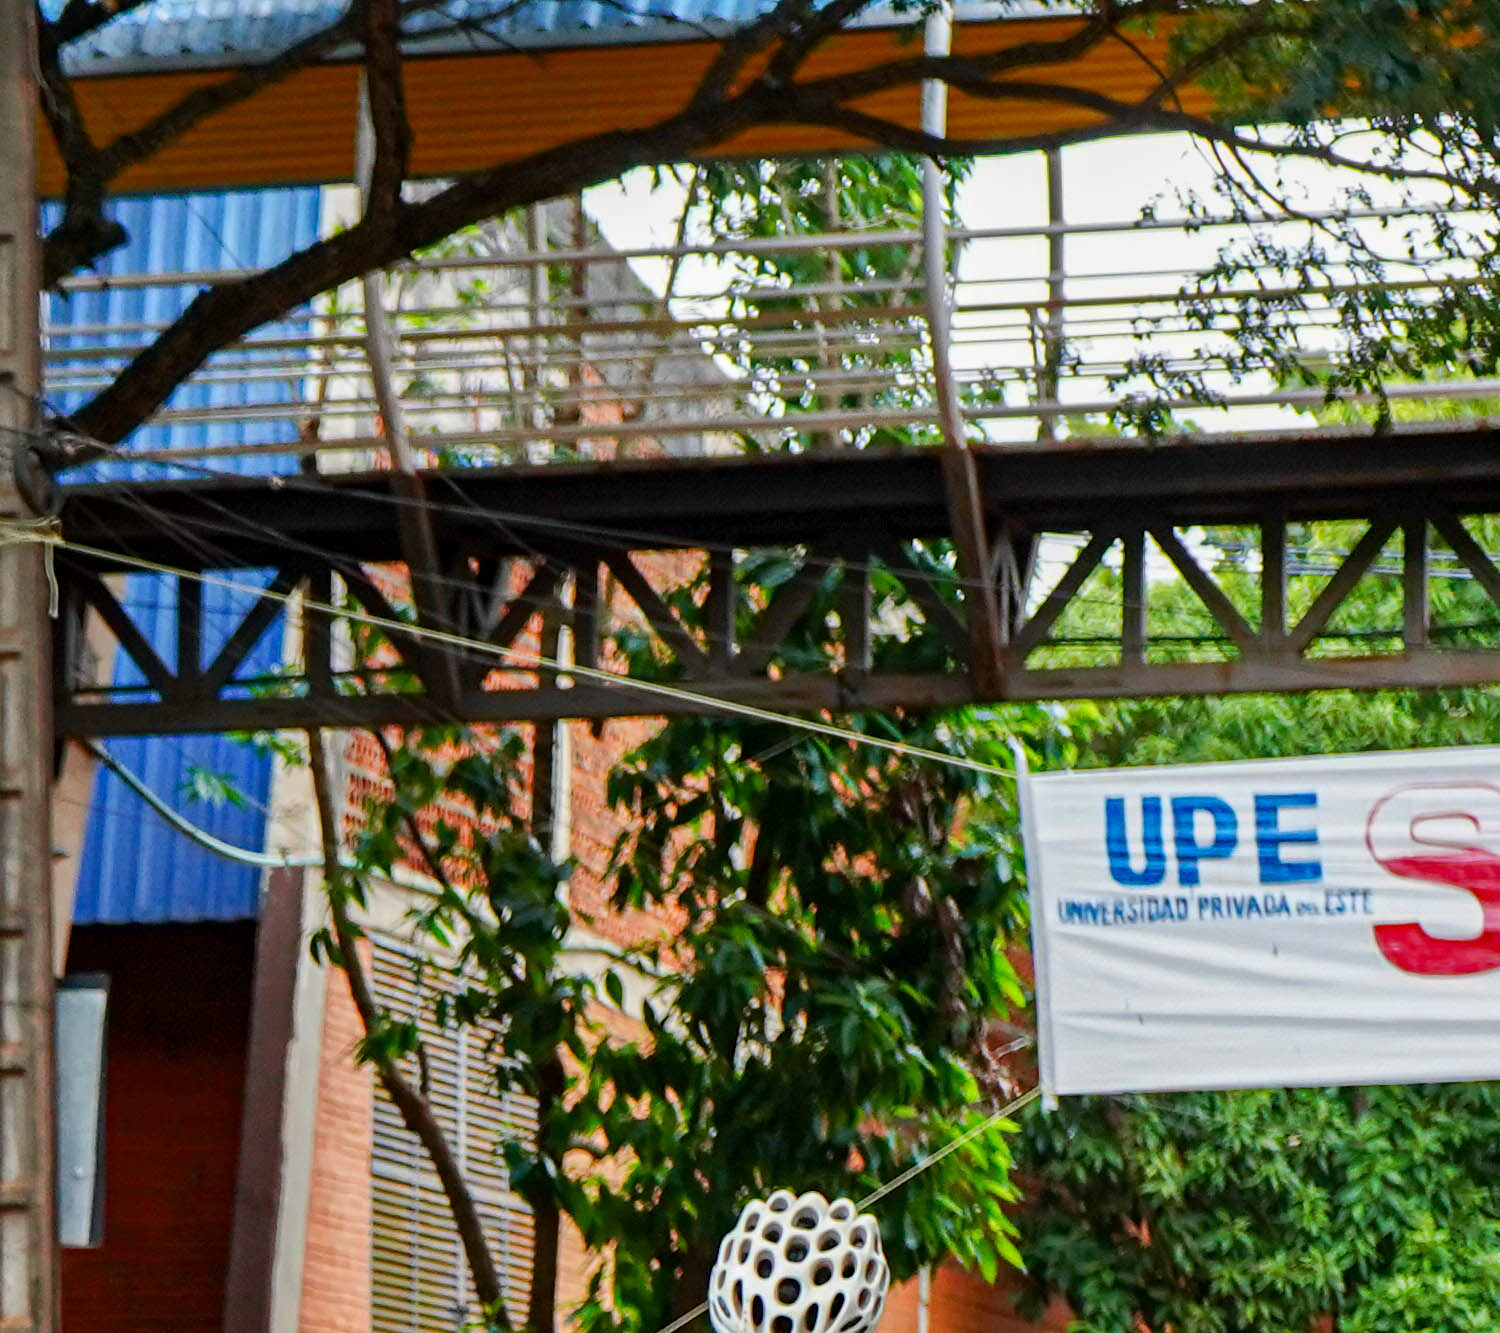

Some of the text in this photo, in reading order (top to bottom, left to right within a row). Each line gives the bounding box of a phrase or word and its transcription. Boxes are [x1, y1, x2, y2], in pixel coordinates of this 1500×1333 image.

[1105, 792, 1323, 887] UPE
[1057, 896, 1188, 926] UNIVERSIDAD
[1199, 895, 1292, 922] PRIVADA
[1324, 888, 1374, 915] ESTE
